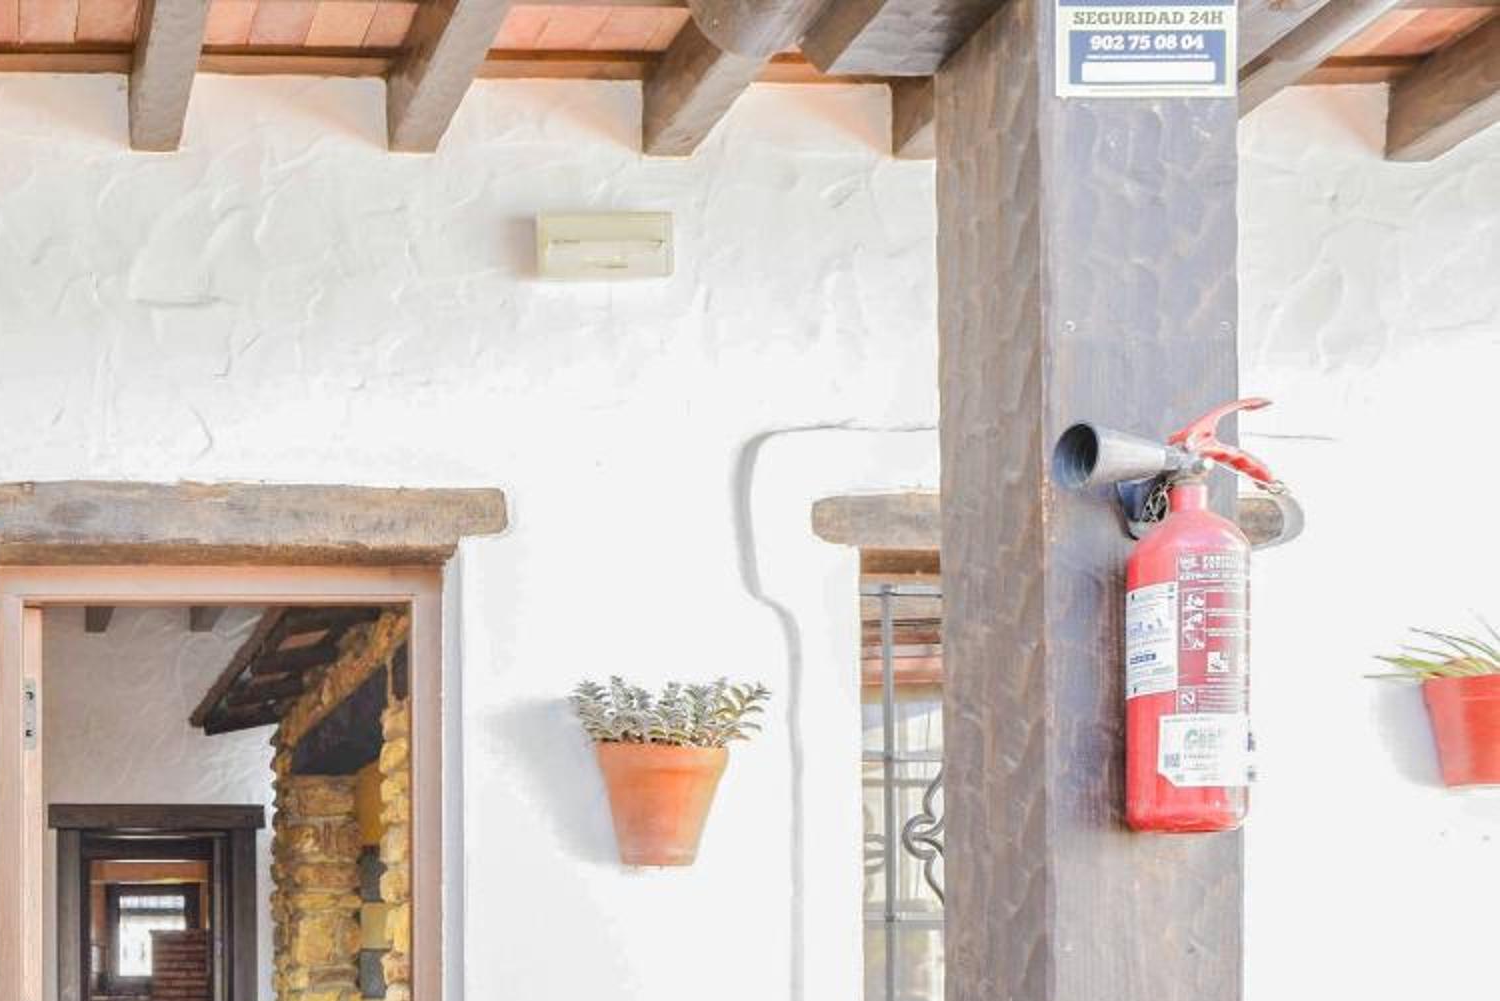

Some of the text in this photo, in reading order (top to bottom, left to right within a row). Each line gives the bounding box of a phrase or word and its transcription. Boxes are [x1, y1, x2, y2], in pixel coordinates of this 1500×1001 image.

[1073, 11, 1223, 25] SEGURIDAD 24H
[1090, 35, 1125, 50] 902
[1128, 35, 1150, 50] 75
[1154, 35, 1177, 50] 08
